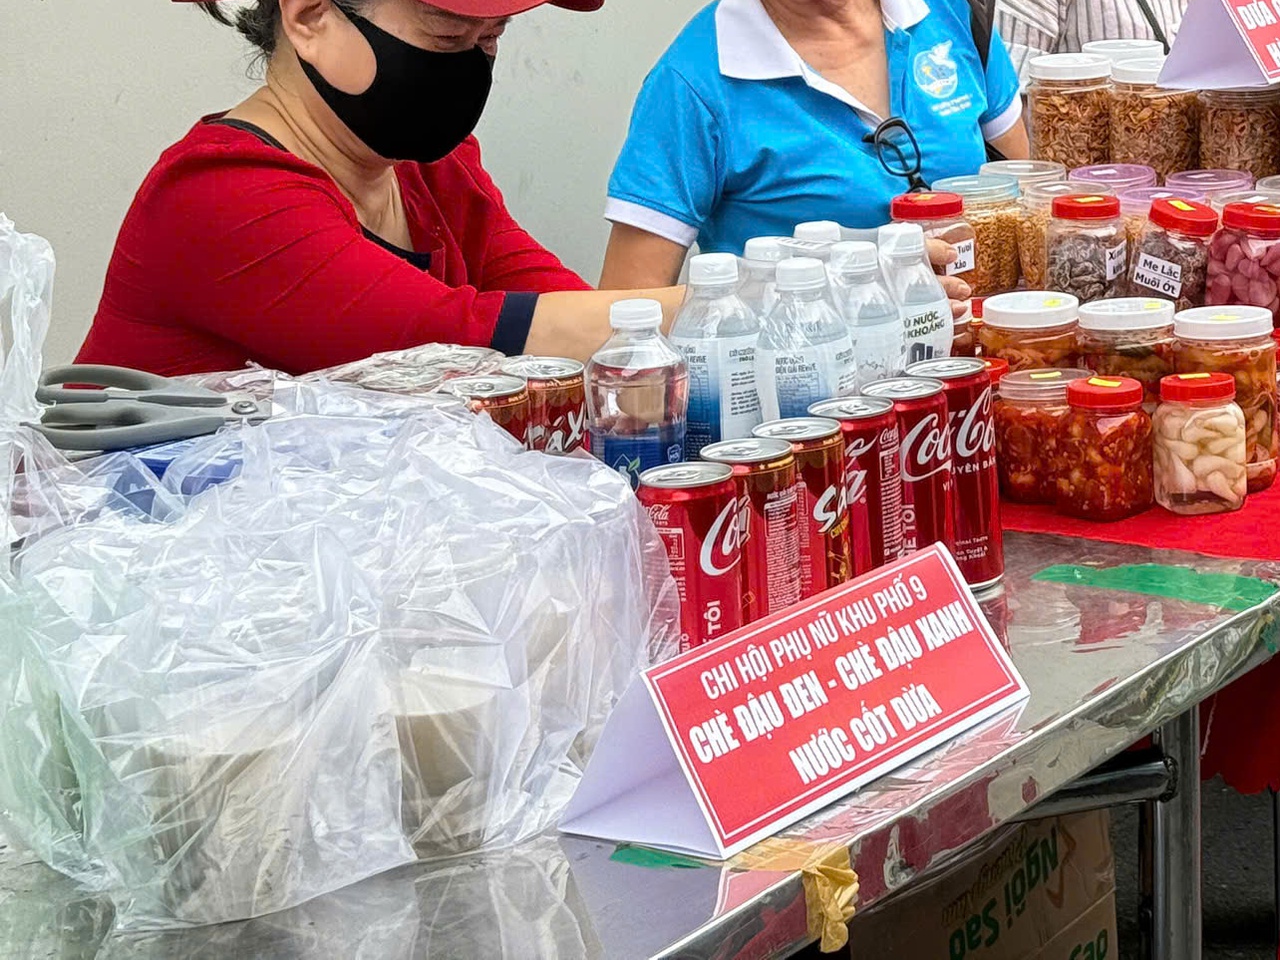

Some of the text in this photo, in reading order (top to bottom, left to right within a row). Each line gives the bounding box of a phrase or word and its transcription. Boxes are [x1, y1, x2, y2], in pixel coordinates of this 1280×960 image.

[1143, 259, 1159, 271] Me
[688, 711, 741, 764] CHÈ
[734, 692, 785, 742] ĐẬU
[780, 670, 829, 720] ĐEN
[834, 641, 884, 692] CHÈ
[877, 624, 923, 671] ĐẬU
[916, 600, 975, 649] XANH
[700, 574, 928, 700] CHI HỘI PHỤ NỮ KHU PHỐ 9
[788, 683, 943, 785] NƯỚC CỐT DỪA
